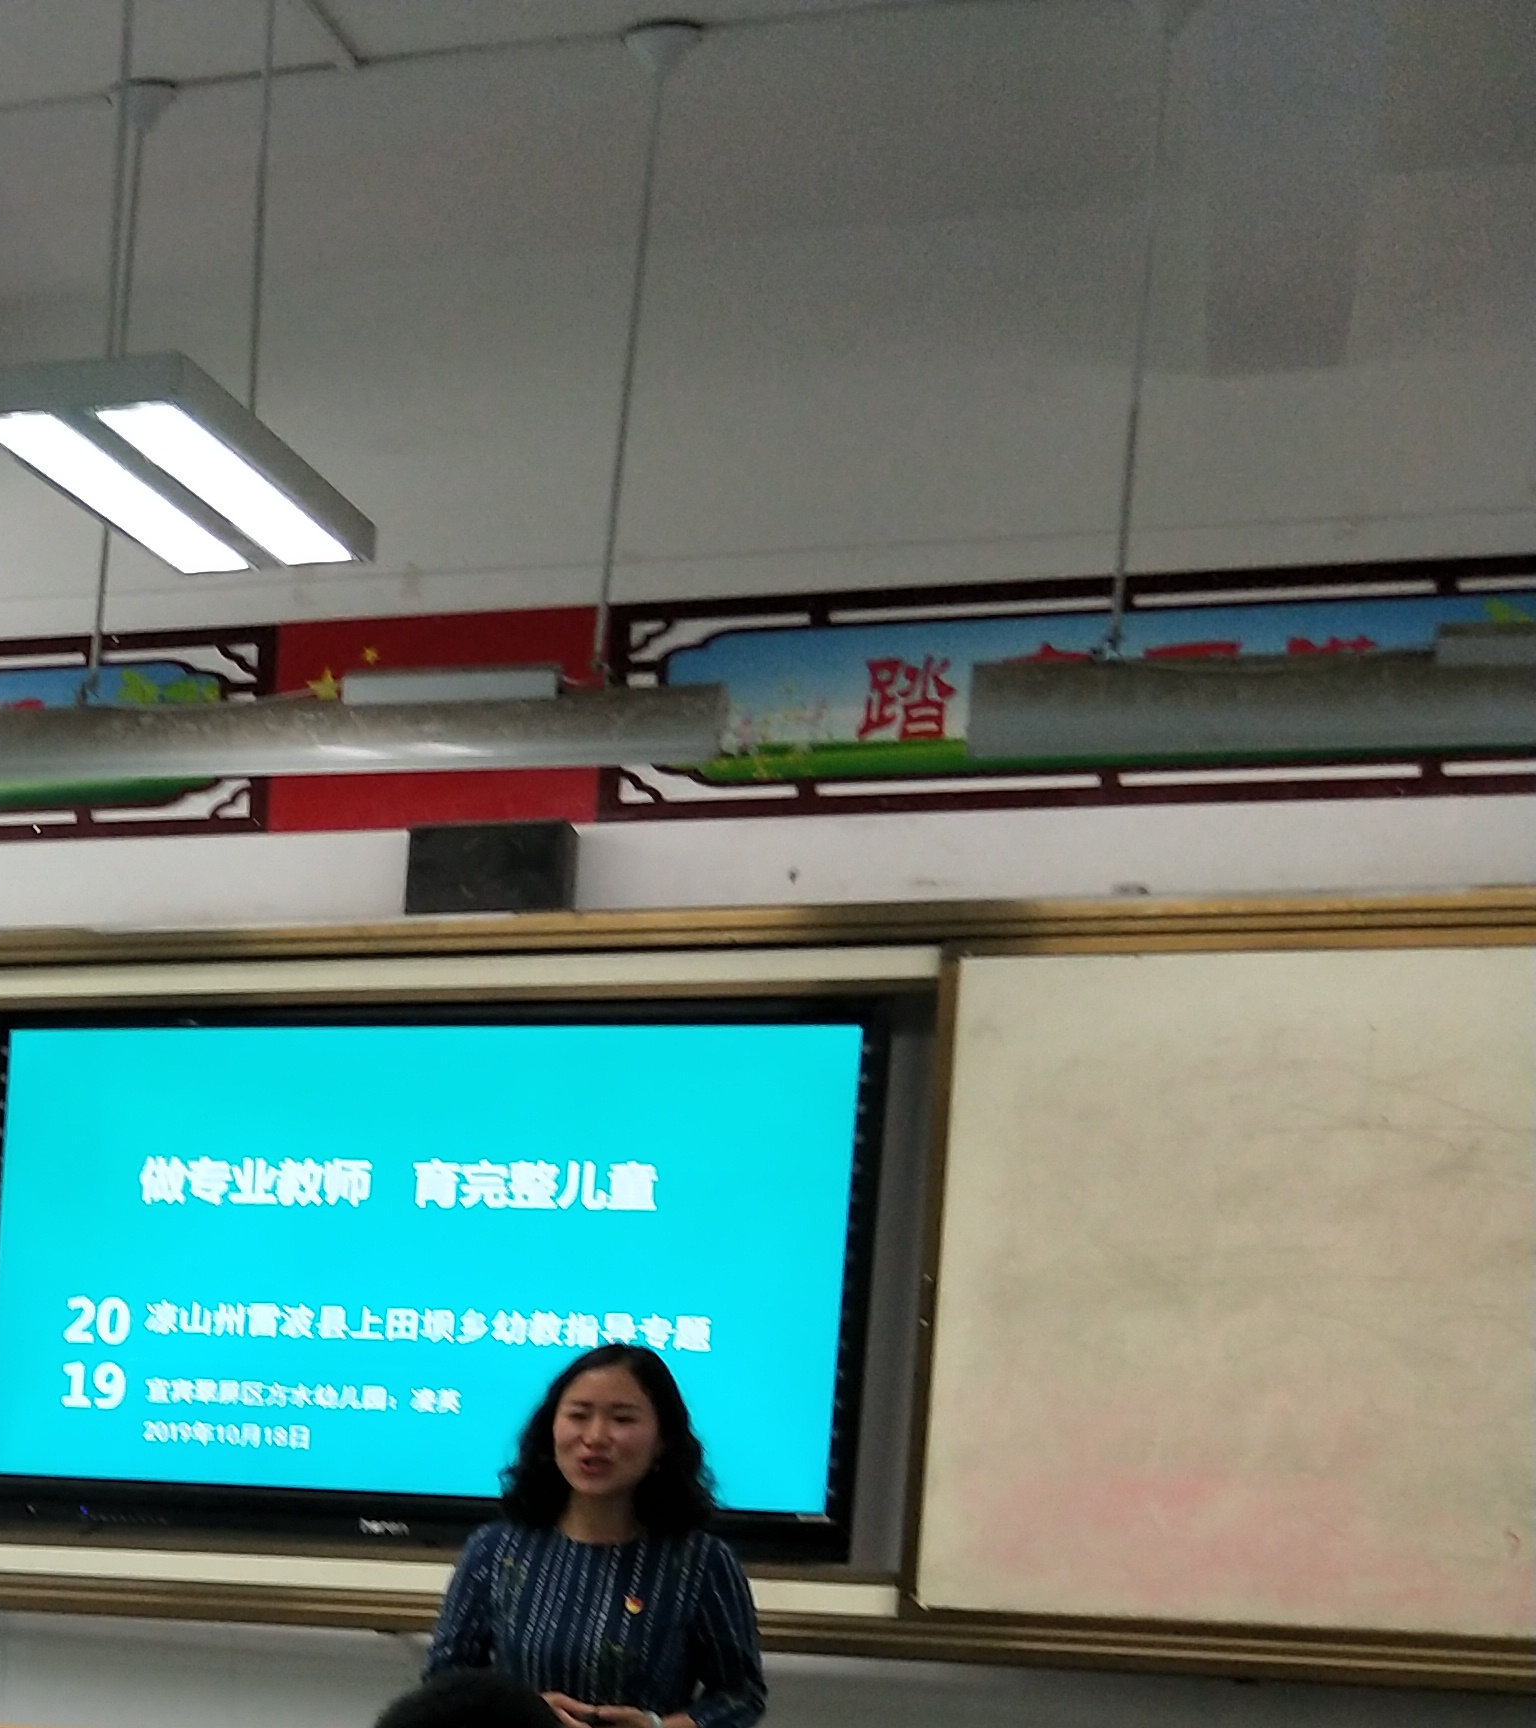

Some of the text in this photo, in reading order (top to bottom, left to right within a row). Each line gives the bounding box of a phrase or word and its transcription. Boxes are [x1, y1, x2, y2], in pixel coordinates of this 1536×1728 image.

[139, 1155, 659, 1212] 做专业教师 育完整儿童
[62, 1295, 131, 1346] 20
[60, 1360, 127, 1411] 19
